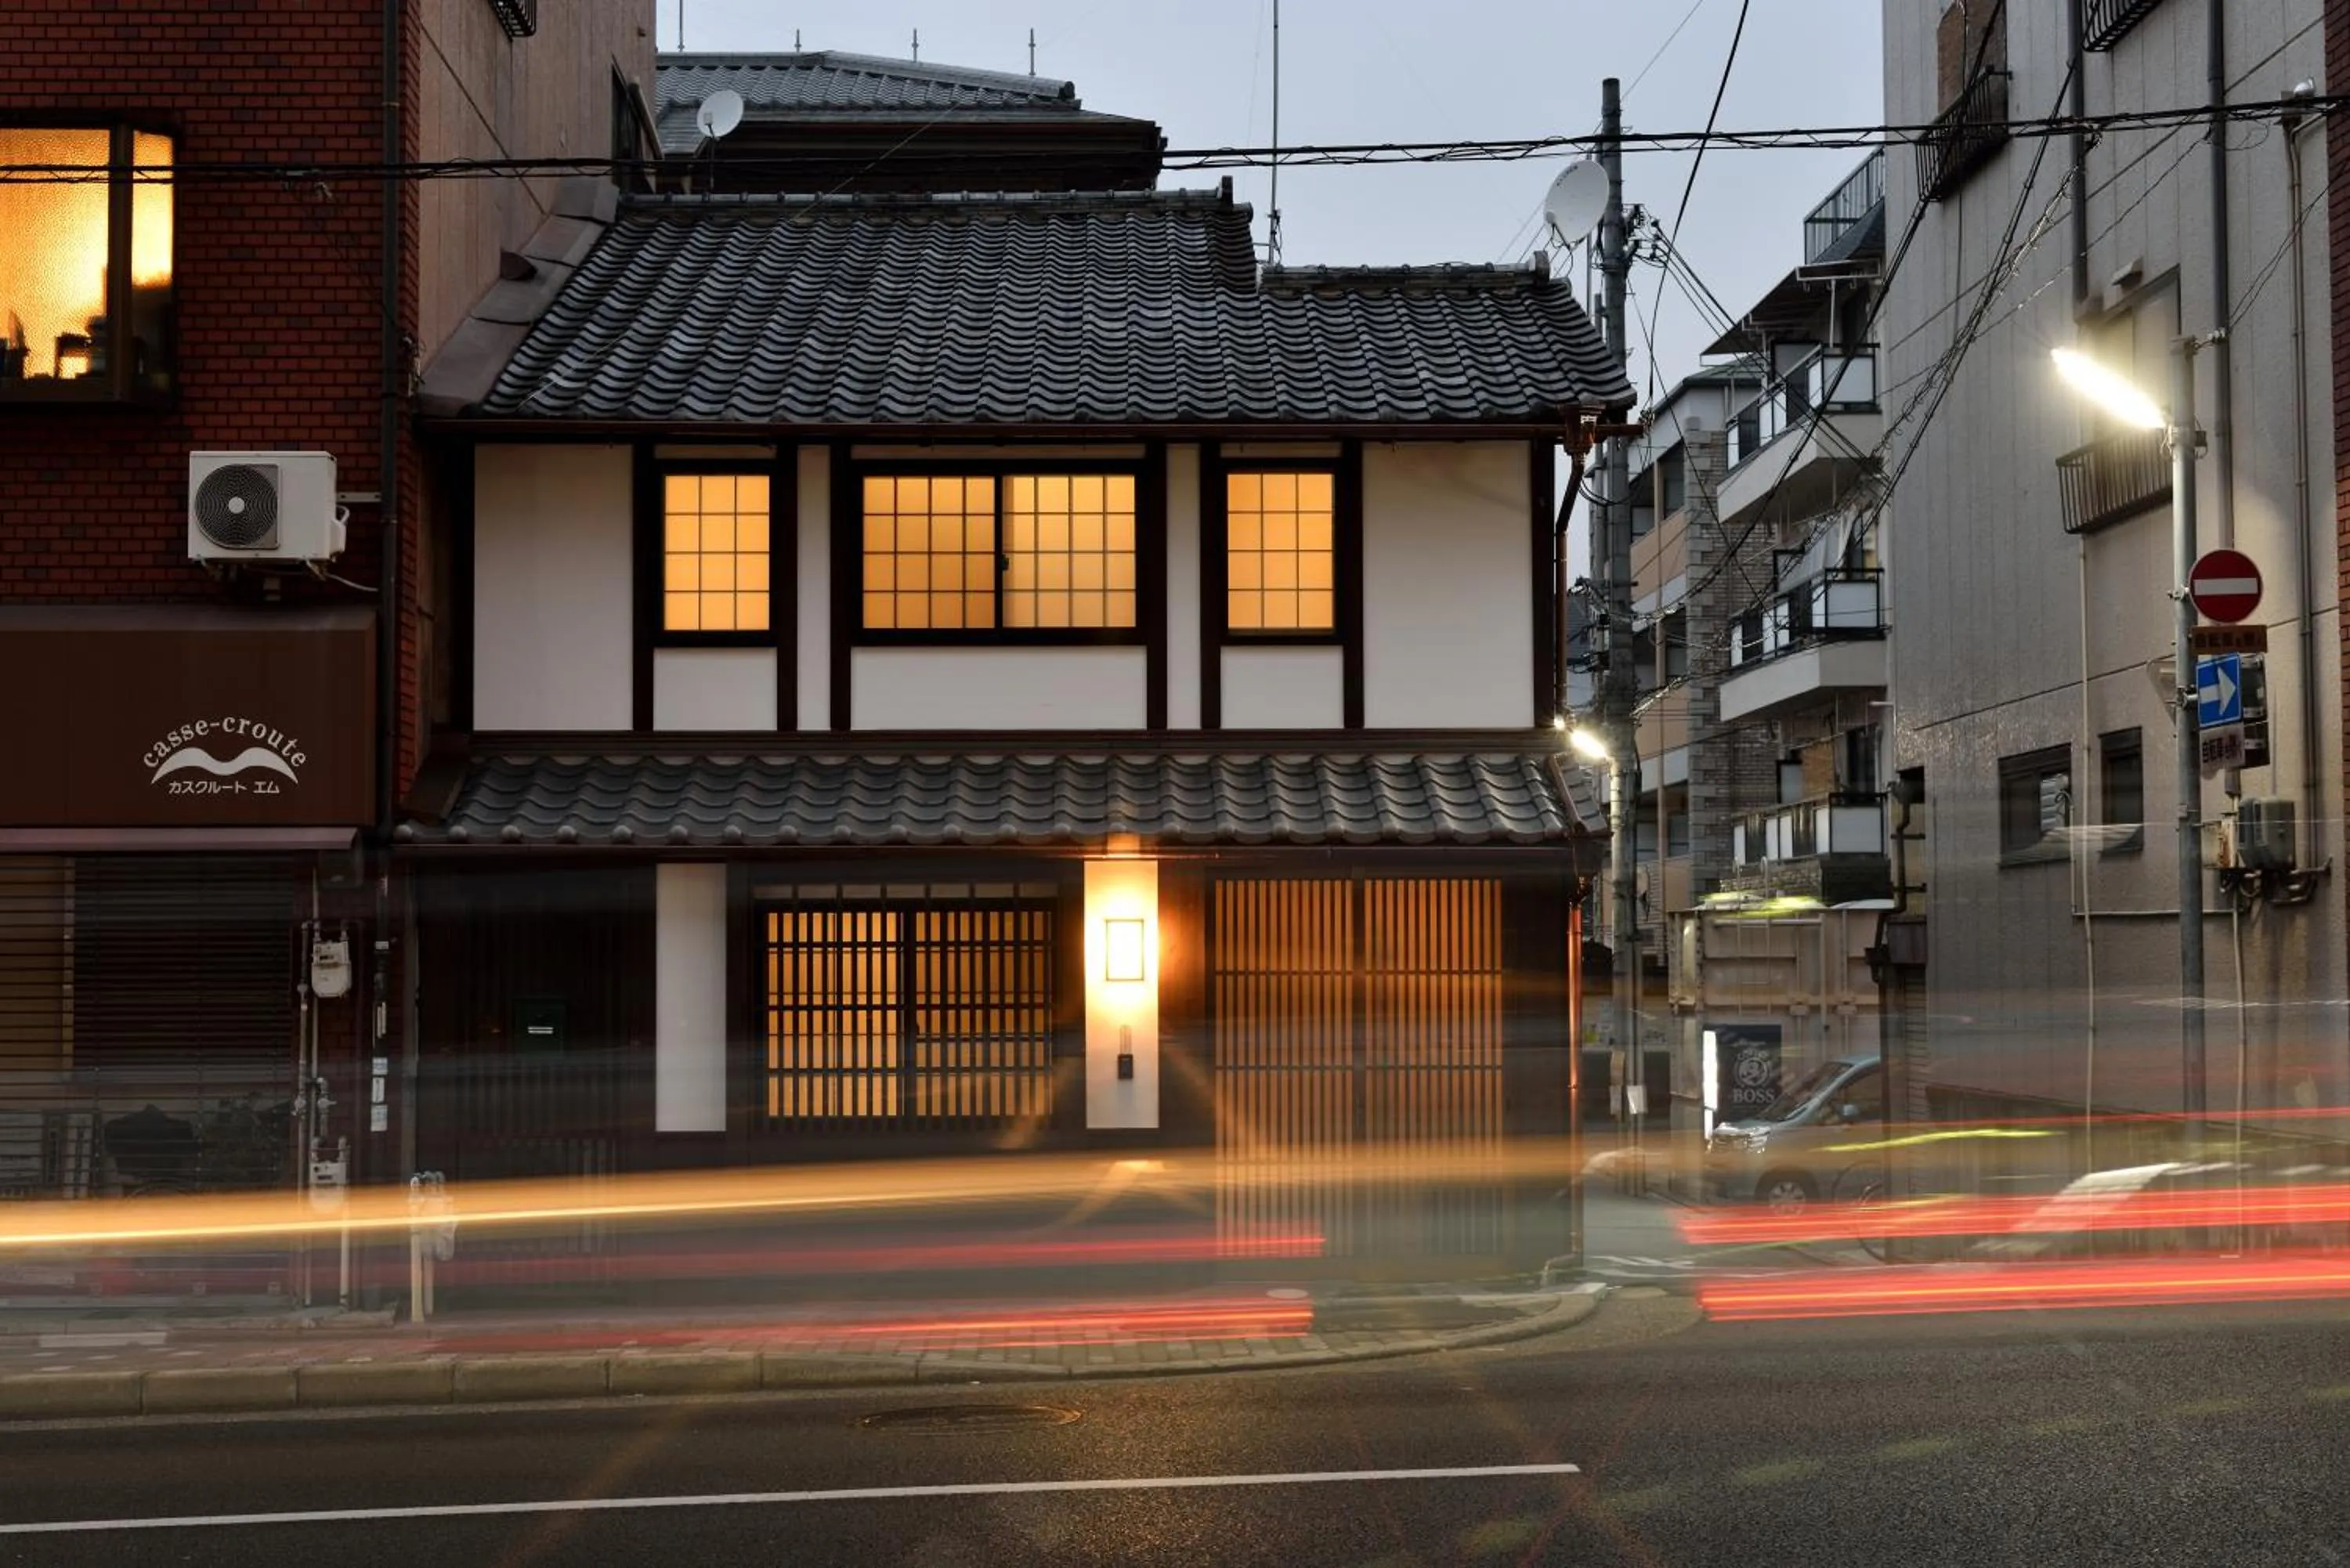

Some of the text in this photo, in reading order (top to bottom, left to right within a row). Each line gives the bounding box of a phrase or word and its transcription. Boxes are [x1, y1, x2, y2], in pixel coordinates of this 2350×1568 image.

[143, 716, 306, 768] casse-croute
[168, 781, 280, 794] カスクルート エム
[1733, 1088, 1775, 1104] BOSS
